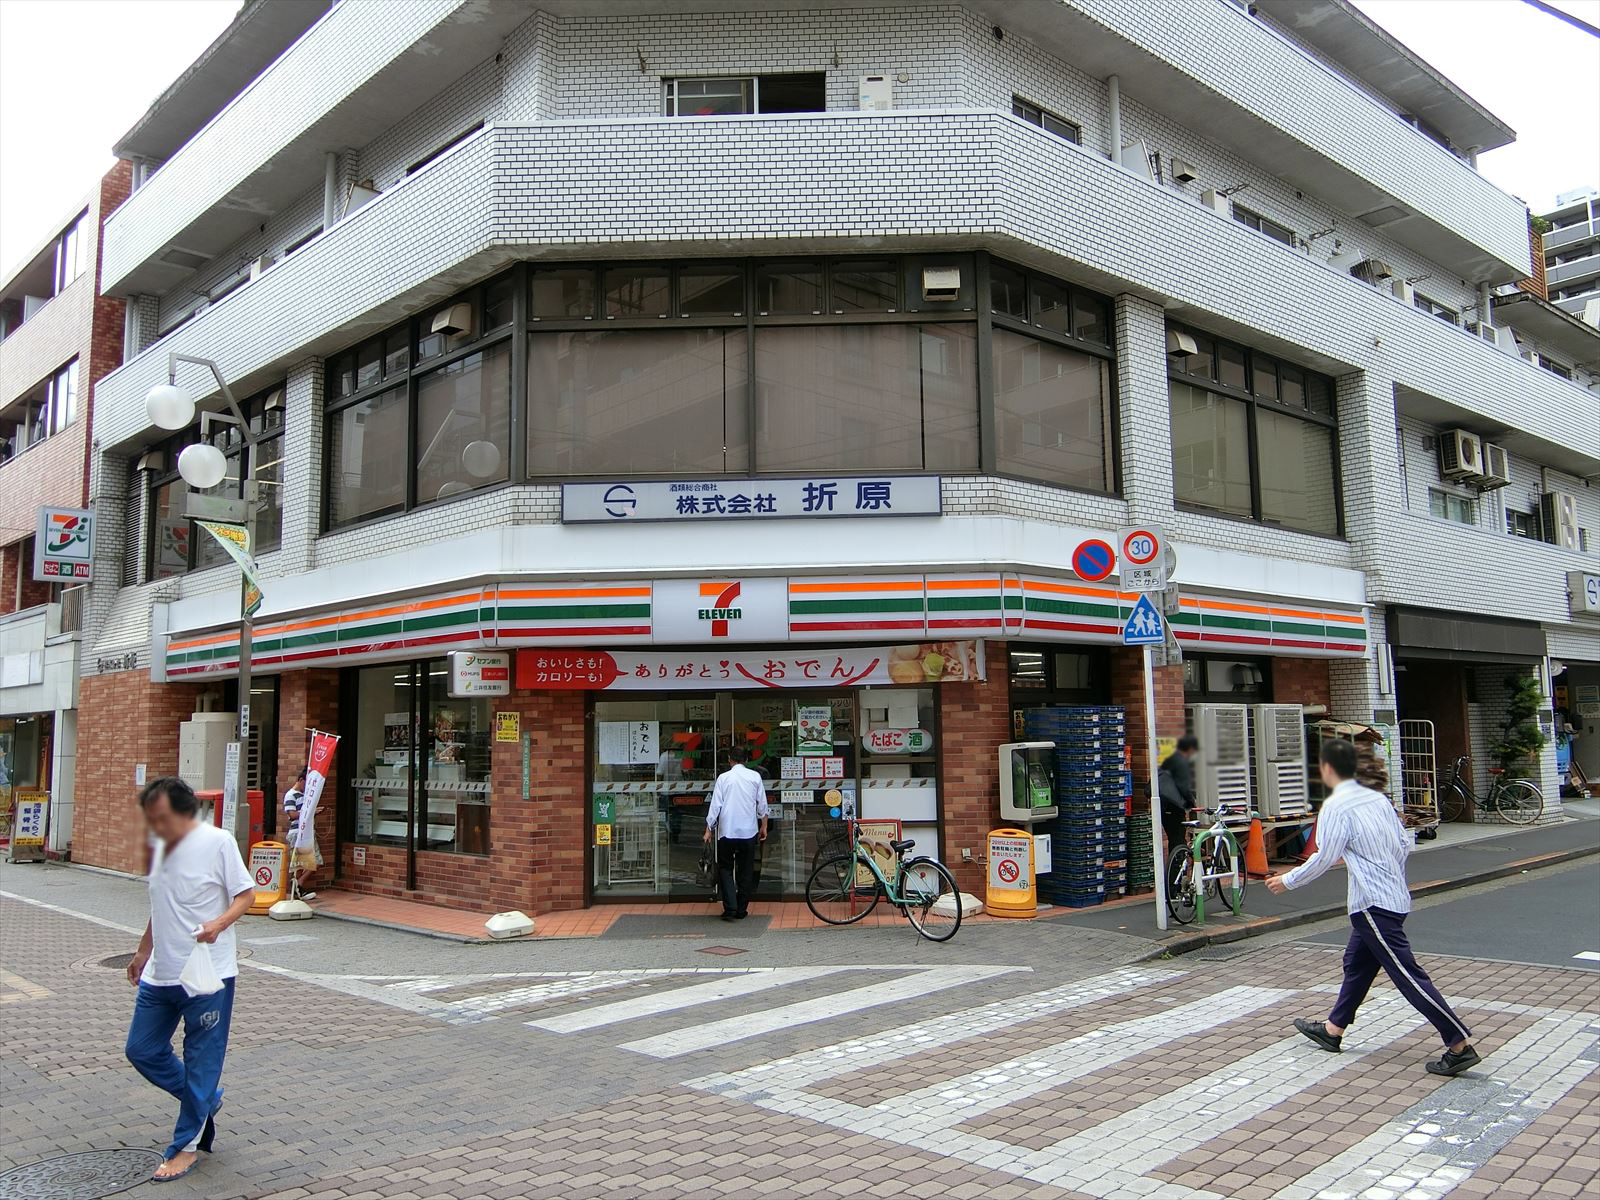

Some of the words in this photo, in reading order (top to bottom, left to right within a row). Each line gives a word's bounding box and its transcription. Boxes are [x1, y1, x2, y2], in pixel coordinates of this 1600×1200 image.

[669, 483, 718, 492] 酒類総合商社
[676, 494, 777, 515] 株式会社
[1131, 540, 1151, 555] 30
[45, 564, 59, 573] たばこ
[75, 566, 89, 575] ATM
[1134, 570, 1152, 578] 区域
[1127, 578, 1160, 587] ここから
[634, 660, 731, 679] ありがとう
[763, 658, 856, 679] おでん
[640, 722, 650, 754] おでん
[872, 733, 902, 746] たばこ
[909, 732, 922, 746] 酒
[32, 803, 42, 836] らくらく
